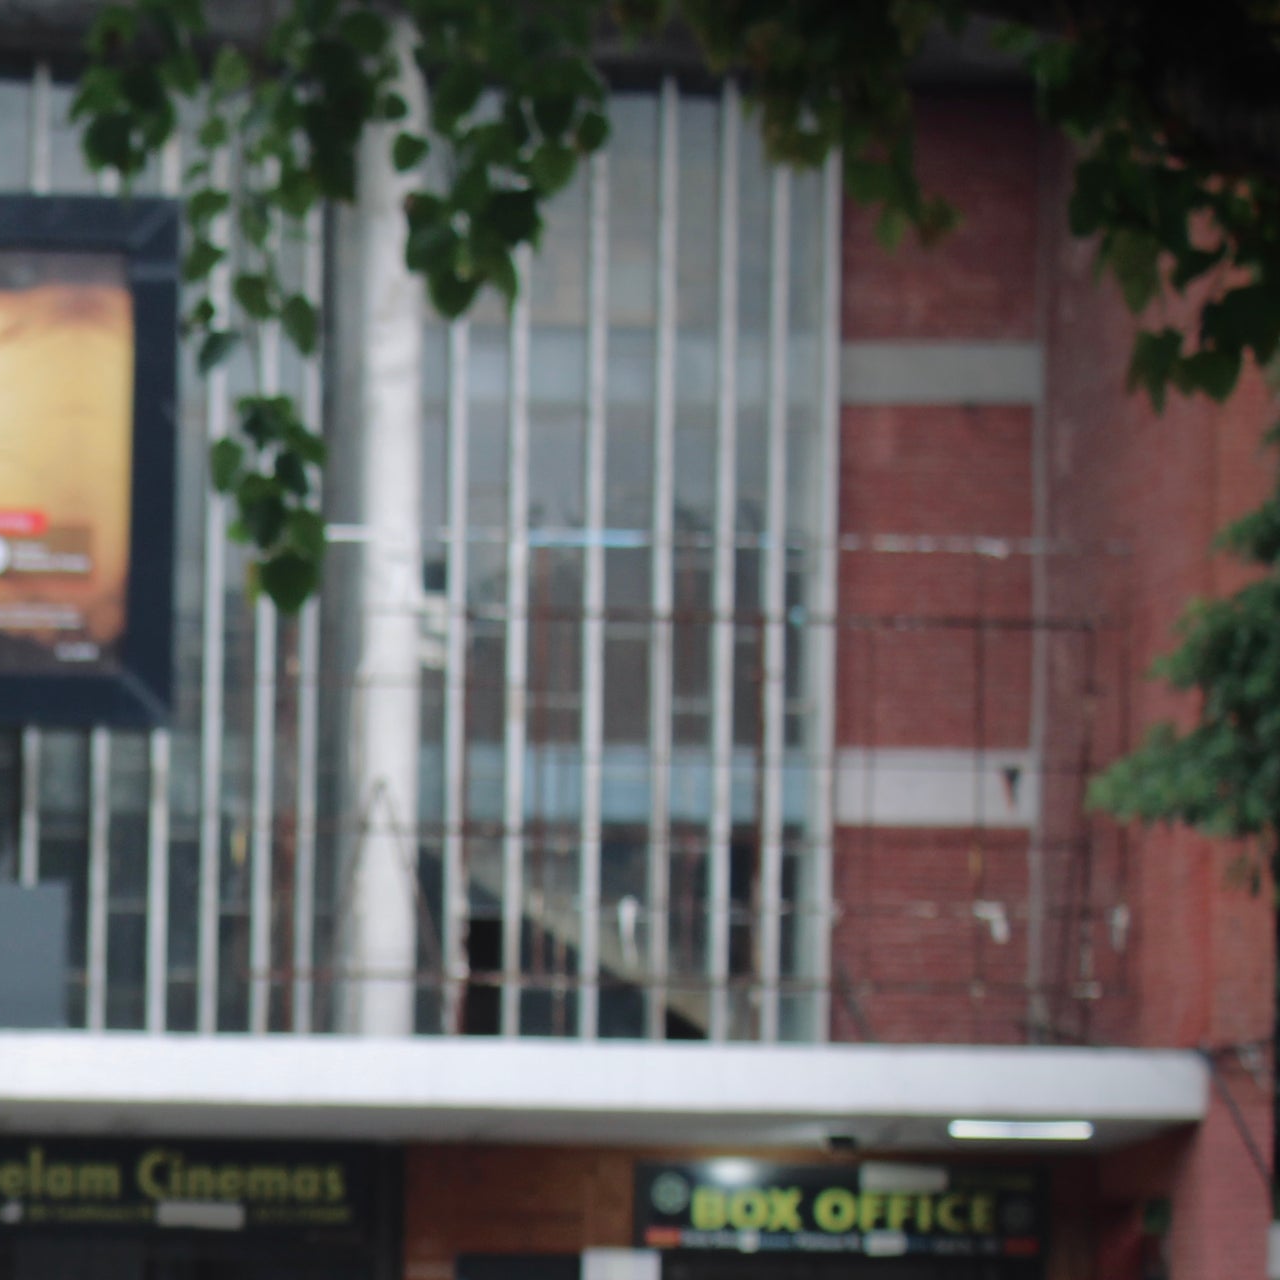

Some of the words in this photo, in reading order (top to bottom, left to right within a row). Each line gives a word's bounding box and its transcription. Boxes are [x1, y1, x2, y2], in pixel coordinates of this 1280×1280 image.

[137, 1149, 347, 1201] Cinemas
[690, 1186, 802, 1232] BOX
[813, 1186, 996, 1234] OFFICE
